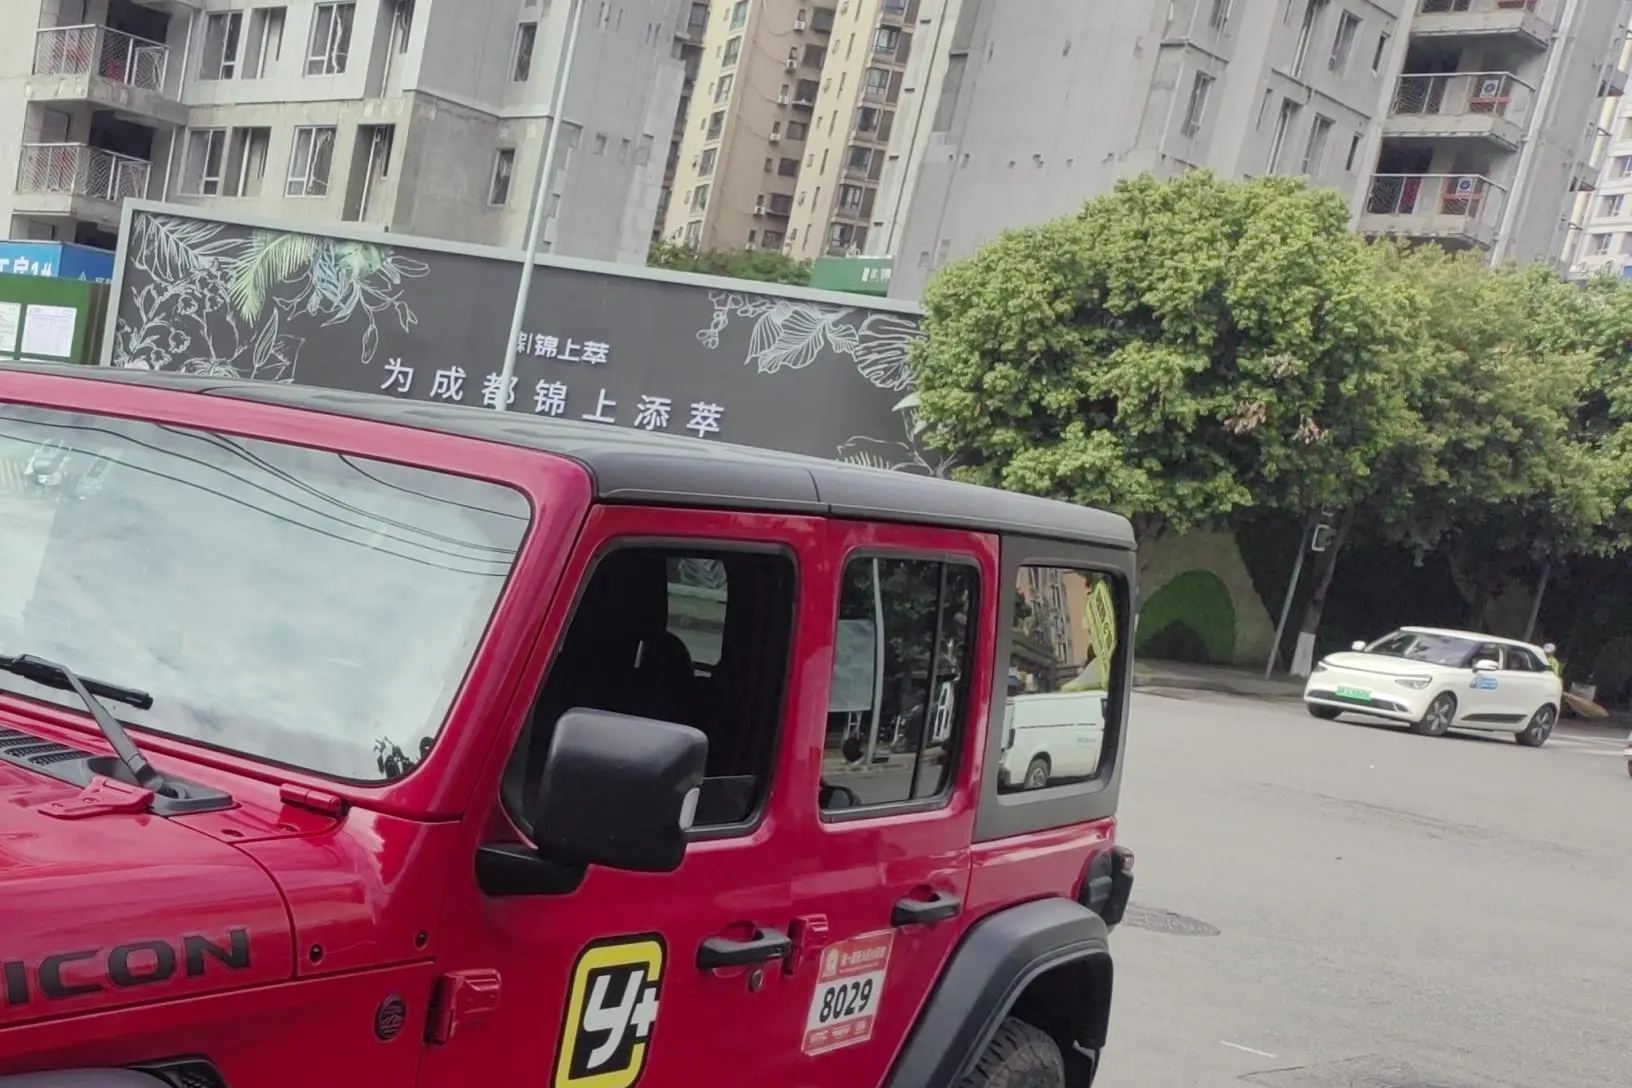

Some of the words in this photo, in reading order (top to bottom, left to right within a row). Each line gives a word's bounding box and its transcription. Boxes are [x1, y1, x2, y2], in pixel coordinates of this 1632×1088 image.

[381, 357, 725, 439] 为成都锦上添萃
[819, 978, 873, 1023] 8029
